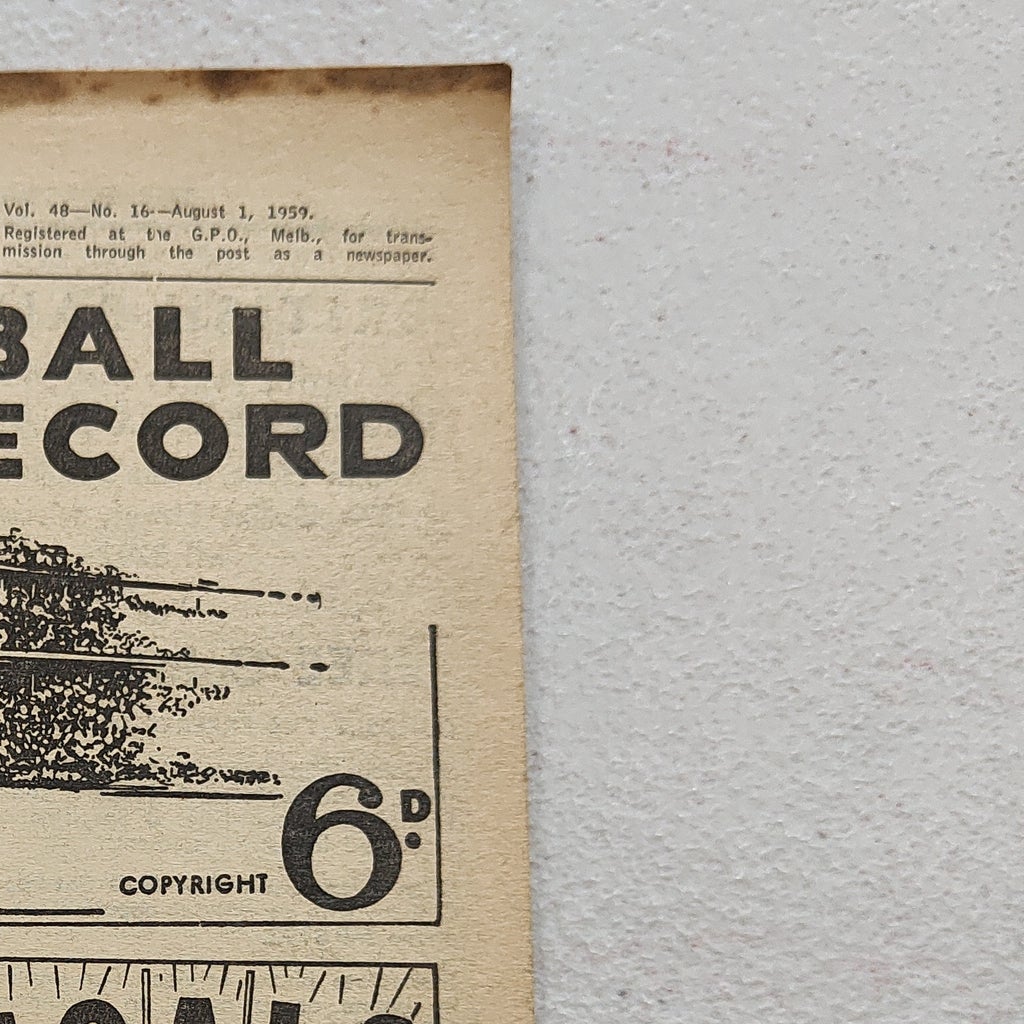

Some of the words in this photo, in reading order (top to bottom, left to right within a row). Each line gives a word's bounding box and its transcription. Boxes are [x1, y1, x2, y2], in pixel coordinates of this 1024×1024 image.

[4, 202, 35, 218] Vol.
[238, 205, 255, 222] 1,
[267, 205, 314, 220] 1959.
[4, 225, 87, 243] Registered
[108, 228, 126, 241] at
[191, 226, 249, 245] G.P.O.,
[271, 228, 322, 246] Melb.,
[342, 228, 365, 244] for
[386, 229, 433, 244] trans-
[2, 244, 62, 259] mission
[85, 245, 145, 262] through
[169, 247, 193, 260] the
[216, 249, 250, 263] post
[274, 250, 290, 261] as
[313, 250, 322, 261] a
[347, 250, 432, 264] newspaper.
[119, 873, 268, 896] COPYRIGHT
